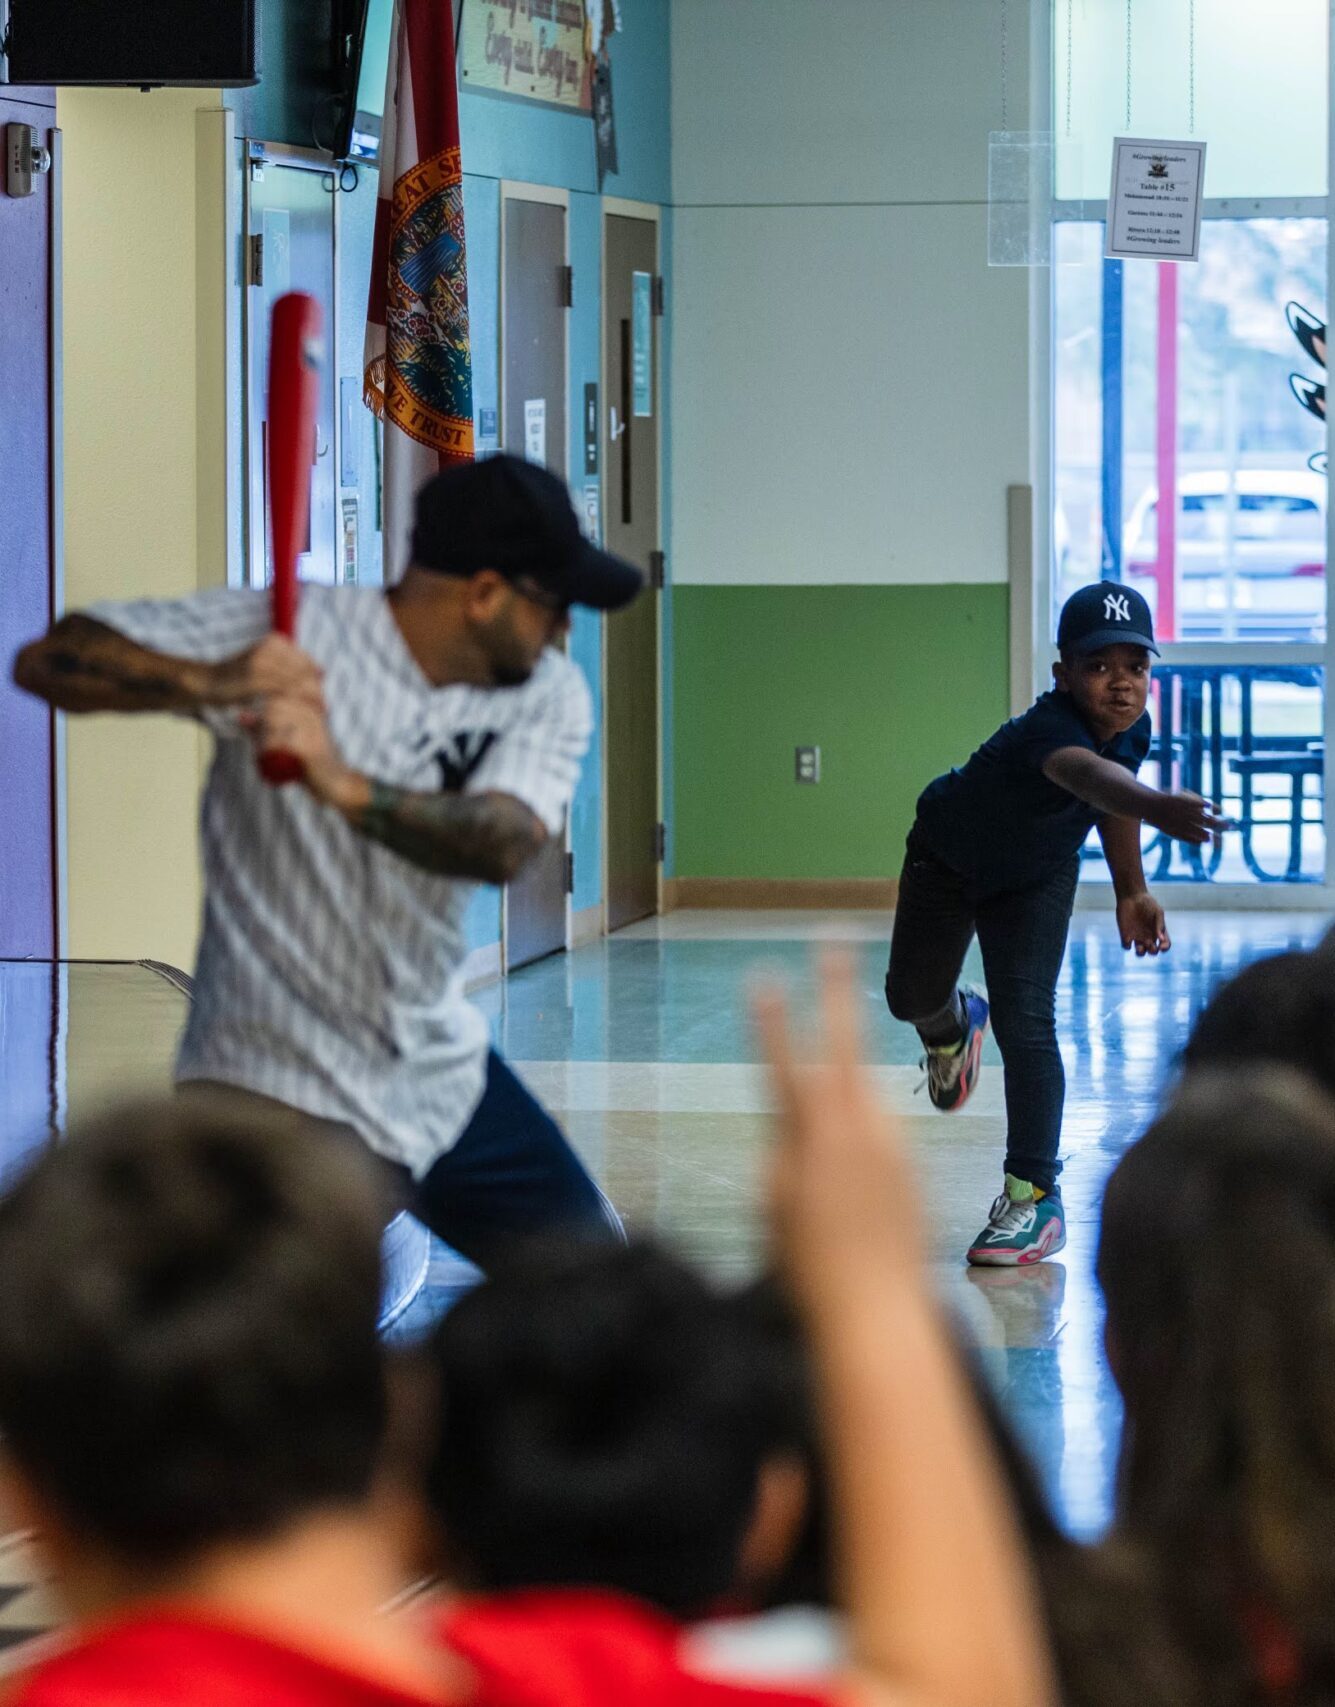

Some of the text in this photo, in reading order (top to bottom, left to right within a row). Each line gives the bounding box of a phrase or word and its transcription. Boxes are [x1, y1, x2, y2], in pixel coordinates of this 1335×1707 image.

[1140, 182, 1175, 192] Table #15
[410, 408, 466, 446] TRUST
[1103, 593, 1131, 621] NY
